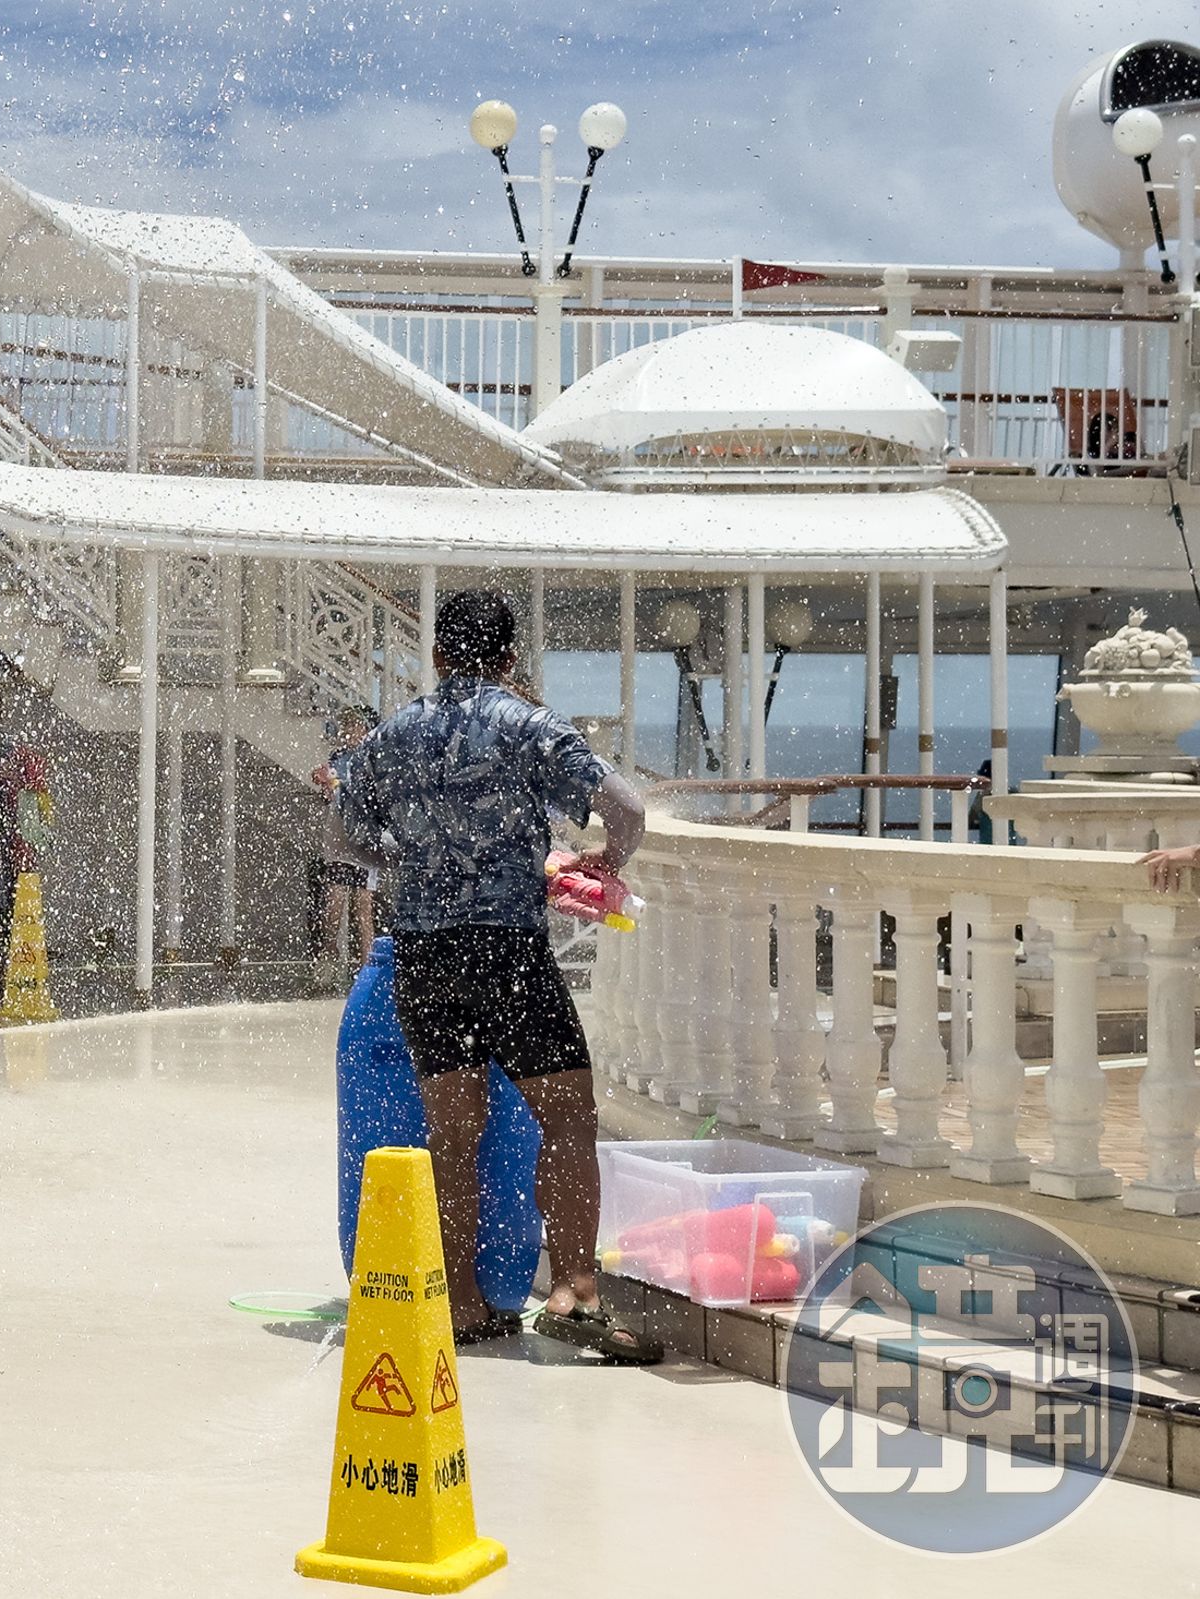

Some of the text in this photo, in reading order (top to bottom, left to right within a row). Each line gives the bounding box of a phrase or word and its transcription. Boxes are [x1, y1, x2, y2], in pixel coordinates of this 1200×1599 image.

[366, 1271, 408, 1288] CAUTION
[360, 1285, 381, 1299] WET
[341, 1454, 419, 1498] 小心地滑
